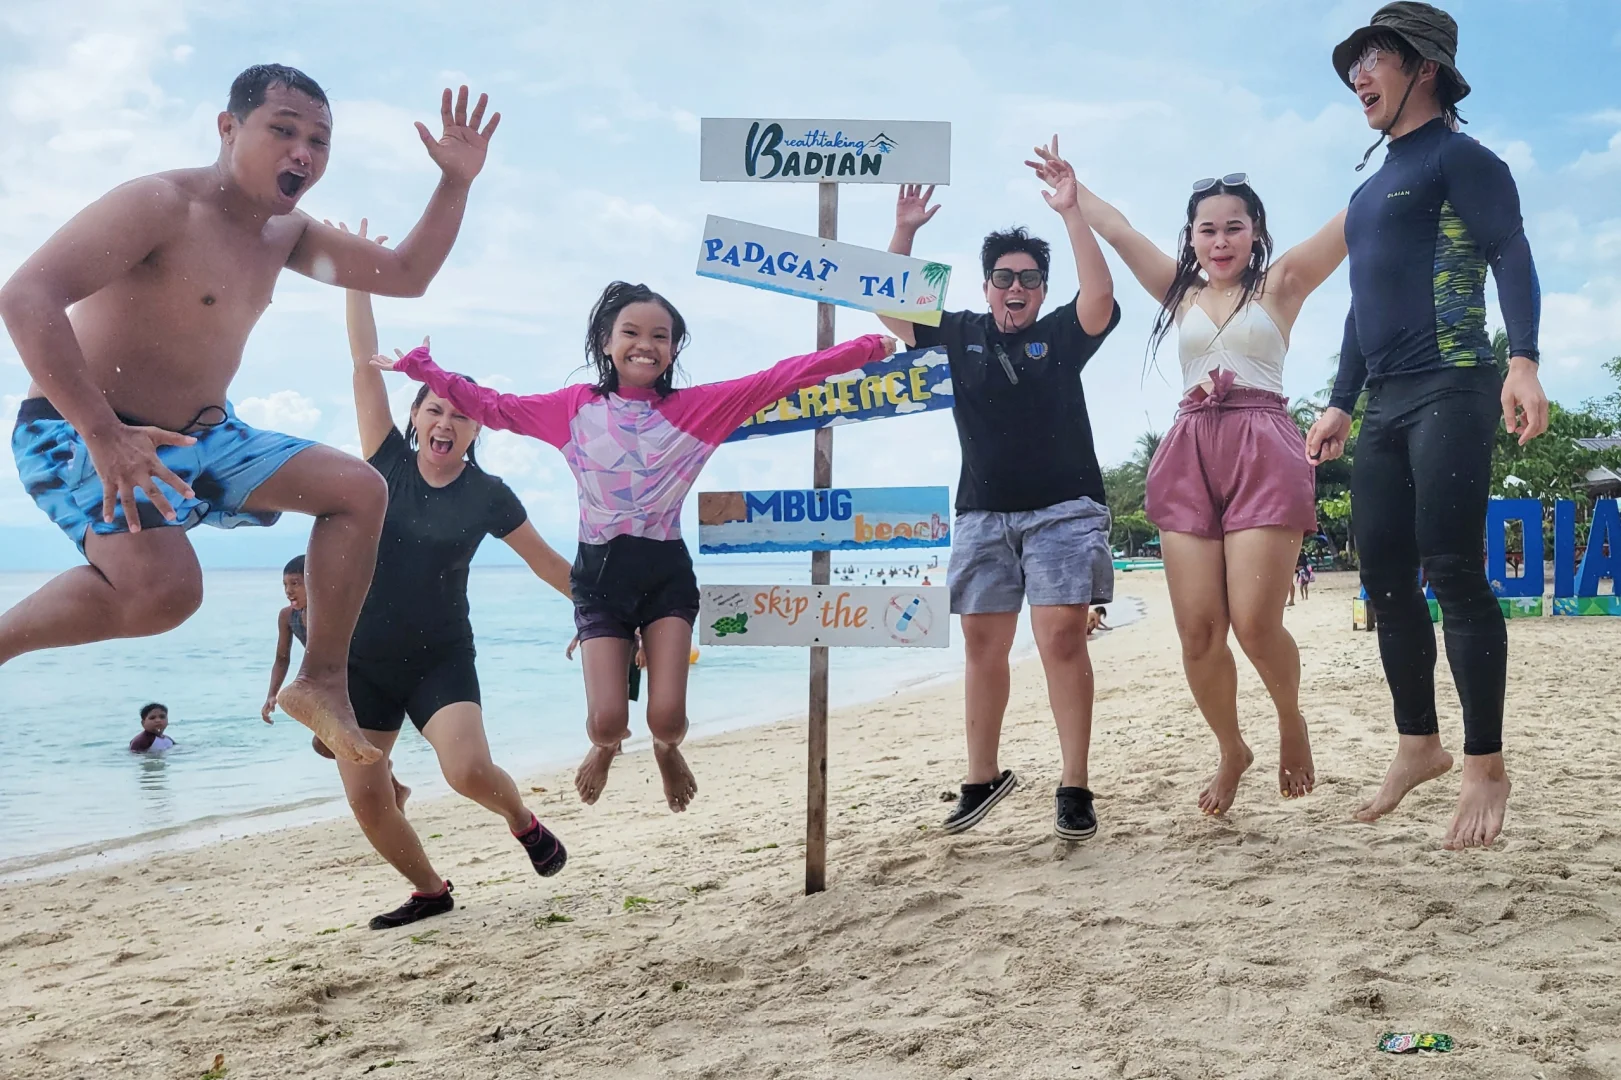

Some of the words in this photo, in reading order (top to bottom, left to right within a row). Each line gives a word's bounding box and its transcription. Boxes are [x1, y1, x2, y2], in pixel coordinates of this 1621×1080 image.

[745, 121, 882, 179] BADIAN
[704, 238, 839, 282] PADAGAT
[859, 270, 910, 304] TA!
[744, 366, 932, 426] PERIENCE
[724, 488, 853, 523] MBUG
[854, 513, 949, 543] beach
[753, 585, 809, 625] skip
[819, 592, 869, 629] the
